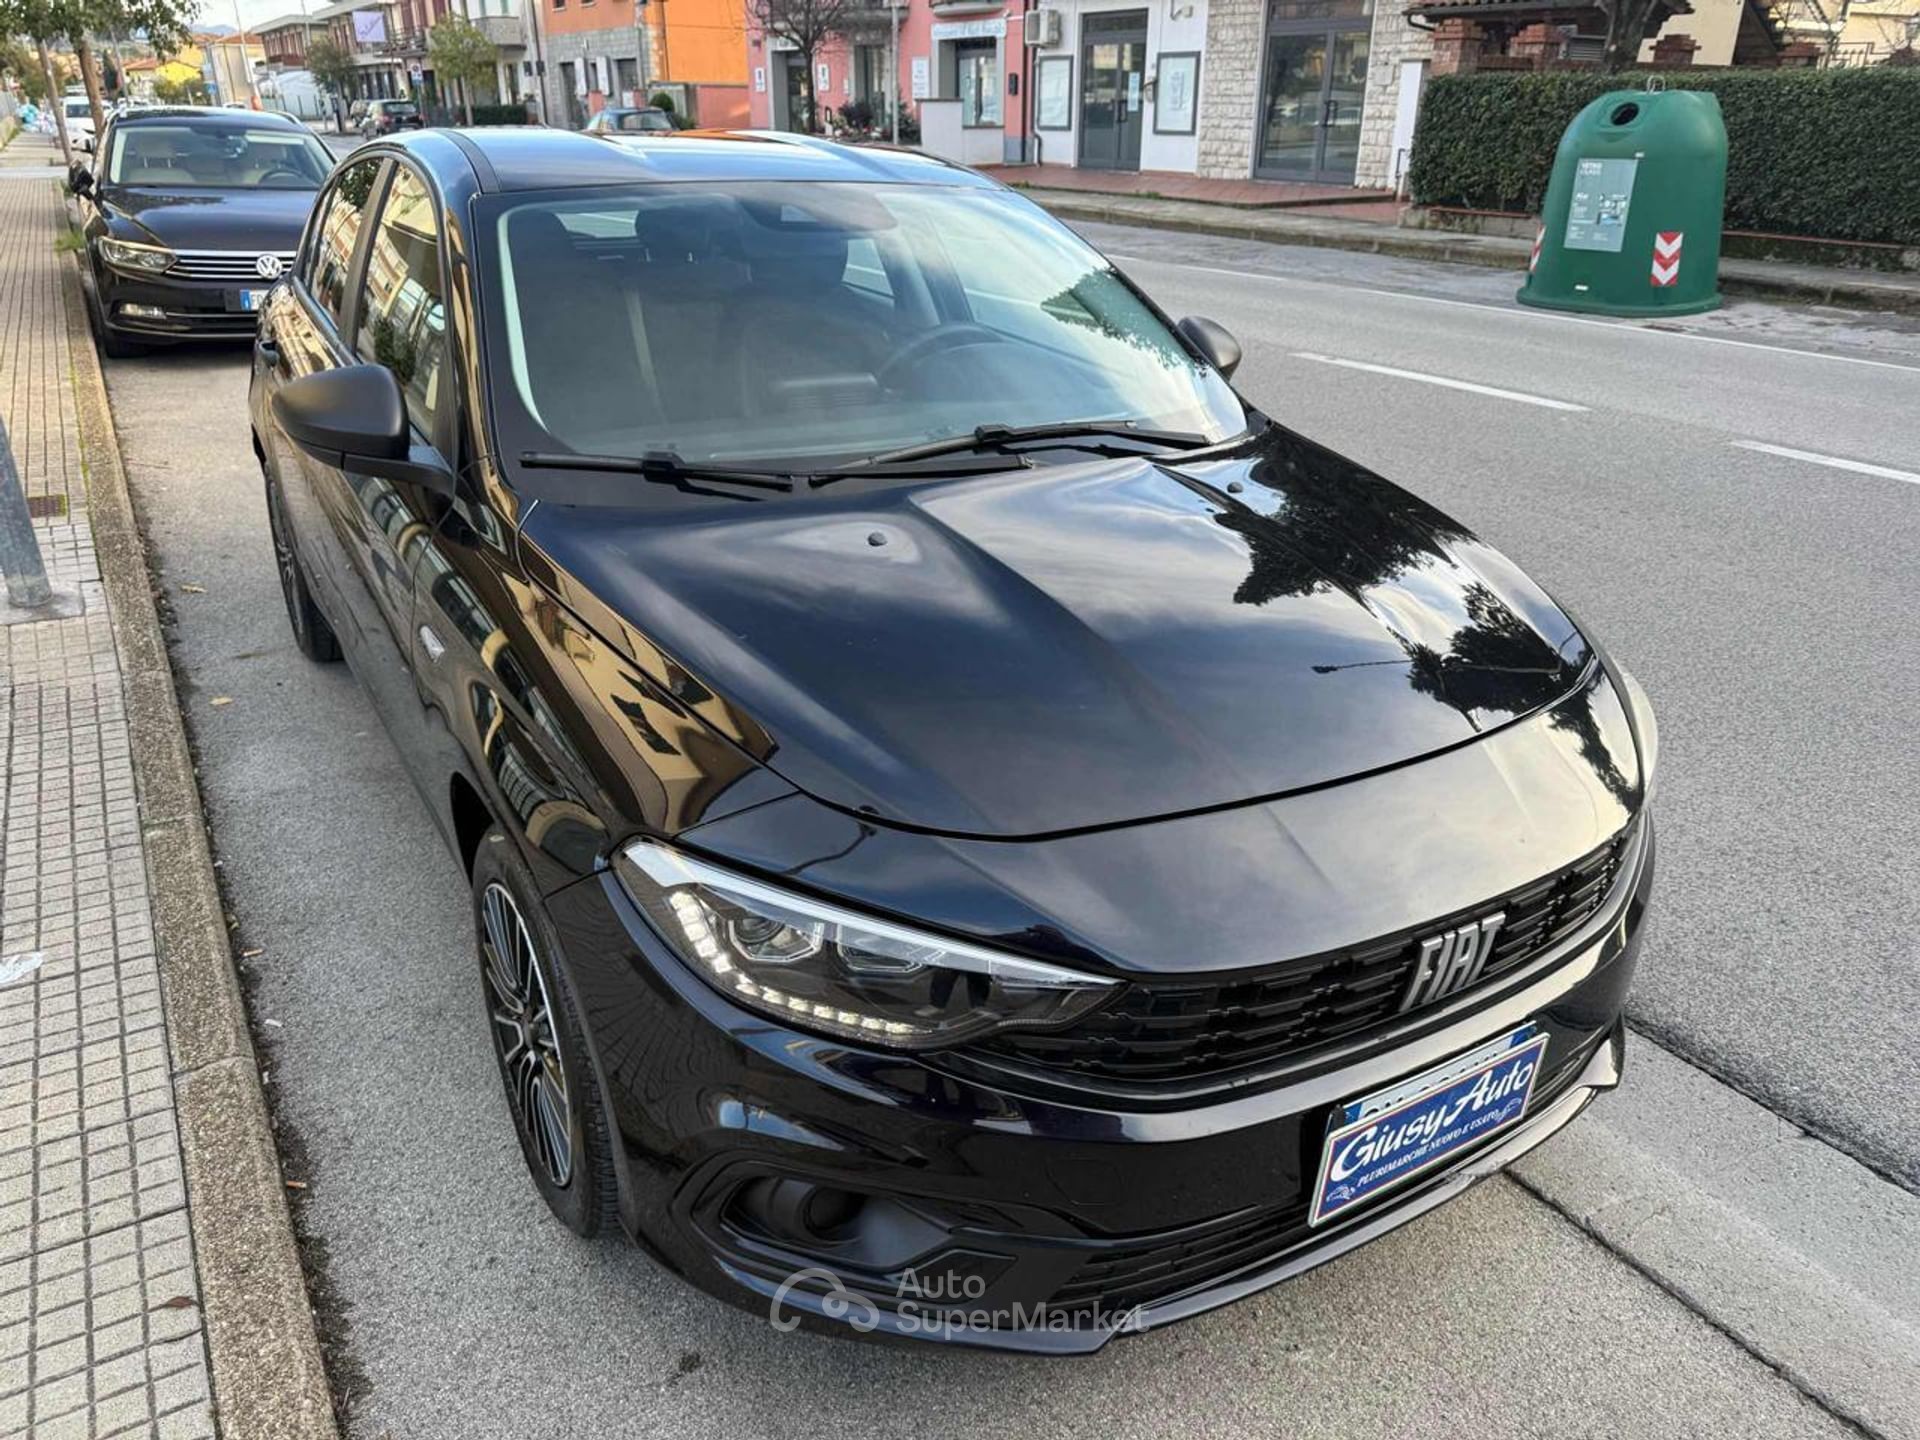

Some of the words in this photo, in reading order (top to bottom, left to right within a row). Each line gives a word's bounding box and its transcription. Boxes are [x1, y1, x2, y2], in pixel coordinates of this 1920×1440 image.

[1399, 911, 1506, 1012] FIAT
[1331, 1105, 1447, 1181] Giusy
[1443, 1060, 1533, 1126] Auto
